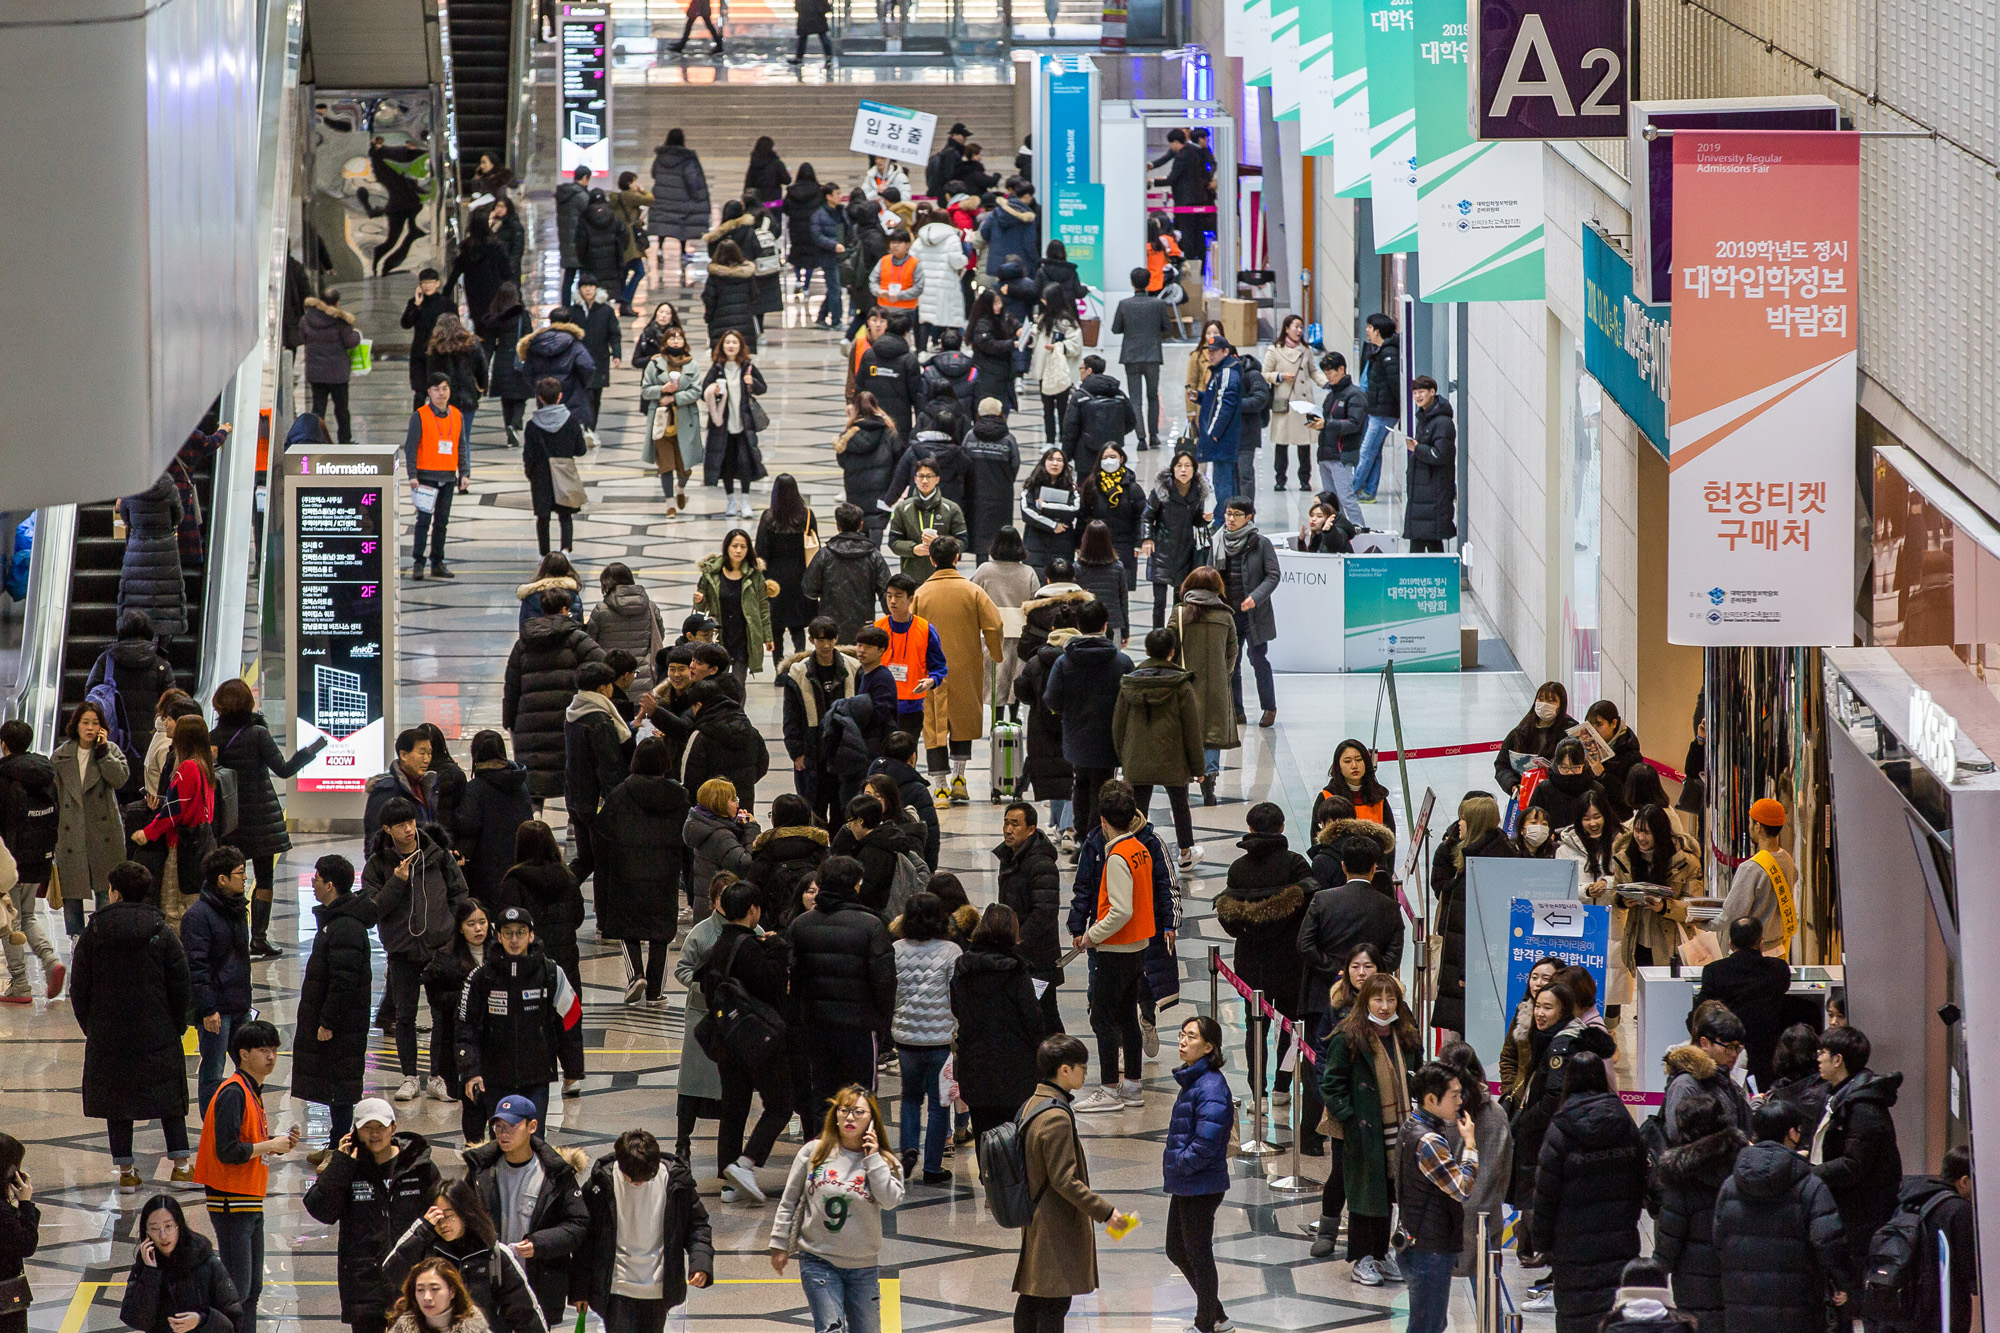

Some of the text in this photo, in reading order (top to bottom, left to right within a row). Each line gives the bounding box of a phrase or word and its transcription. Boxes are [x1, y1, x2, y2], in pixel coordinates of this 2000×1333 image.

[1697, 143, 1721, 152] 2019
[1697, 153, 1783, 164] University Regular
[1697, 164, 1770, 173] Admissions Fair
[1715, 240, 1848, 262] 2019학년도 정시
[1683, 265, 1847, 299] 대학입학정보
[1765, 305, 1847, 338] 박람회
[316, 462, 378, 474] information
[361, 493, 377, 505] 4F
[1703, 481, 1826, 514] 현장티켓
[1717, 519, 1810, 552] 구매처
[361, 541, 377, 554] 3F
[1281, 571, 1327, 585] MATION
[1399, 578, 1447, 586] 2019학년도 정시
[361, 585, 376, 597] 2F
[1387, 587, 1447, 599] 대학입학정보
[1417, 600, 1447, 613] 박람회
[328, 757, 352, 765] 400W
[1524, 936, 1595, 952] 코엑스 아쿠아리움이
[1621, 1093, 1646, 1102] coex
[823, 1196, 847, 1231] 9
